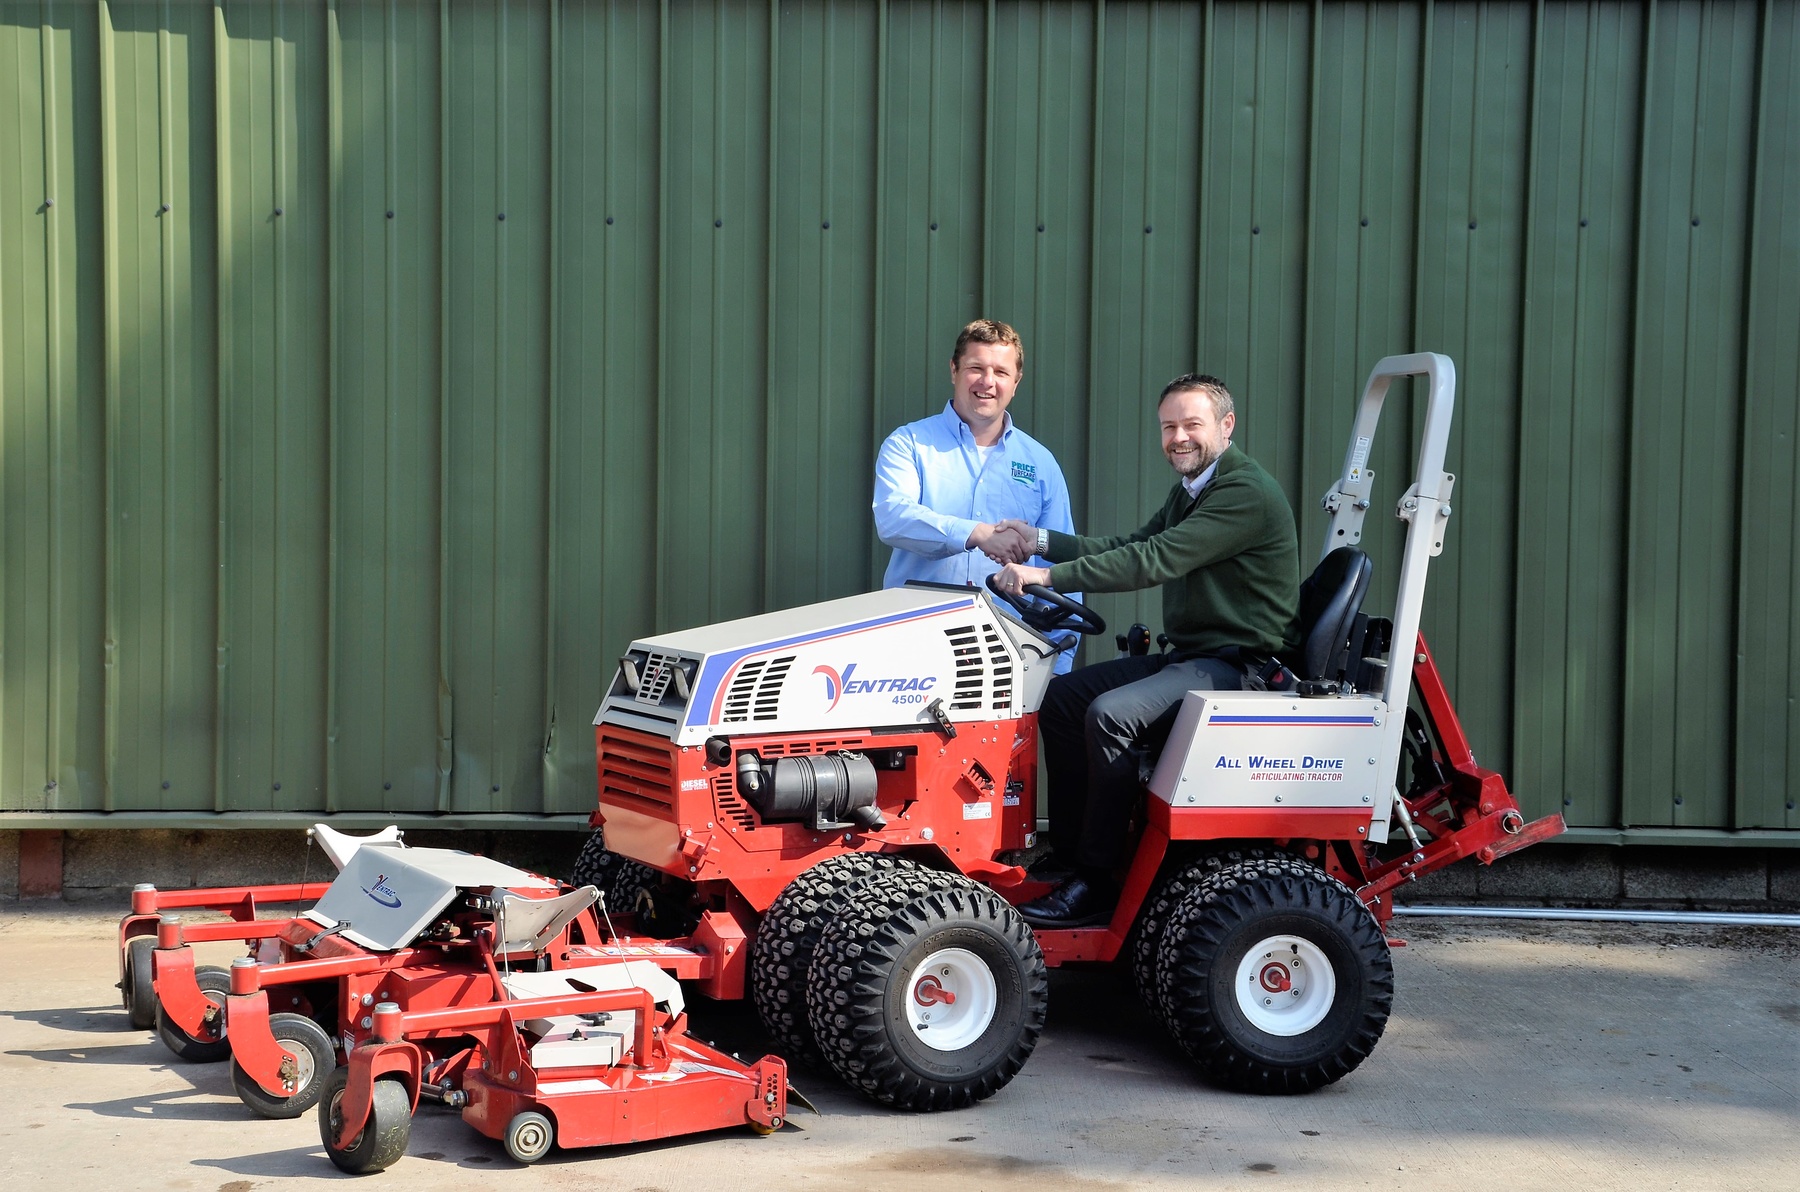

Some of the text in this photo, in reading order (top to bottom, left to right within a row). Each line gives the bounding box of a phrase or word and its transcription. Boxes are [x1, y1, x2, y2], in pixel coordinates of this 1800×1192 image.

[1011, 460, 1036, 474] PRICE
[811, 663, 937, 714] VENTRAC
[891, 694, 929, 705] 4500Y
[1215, 756, 1344, 769] ALL WHEEL DRIVE
[1250, 772, 1343, 781] ARTICULATING TRACTOR
[680, 778, 708, 788] DIESEL
